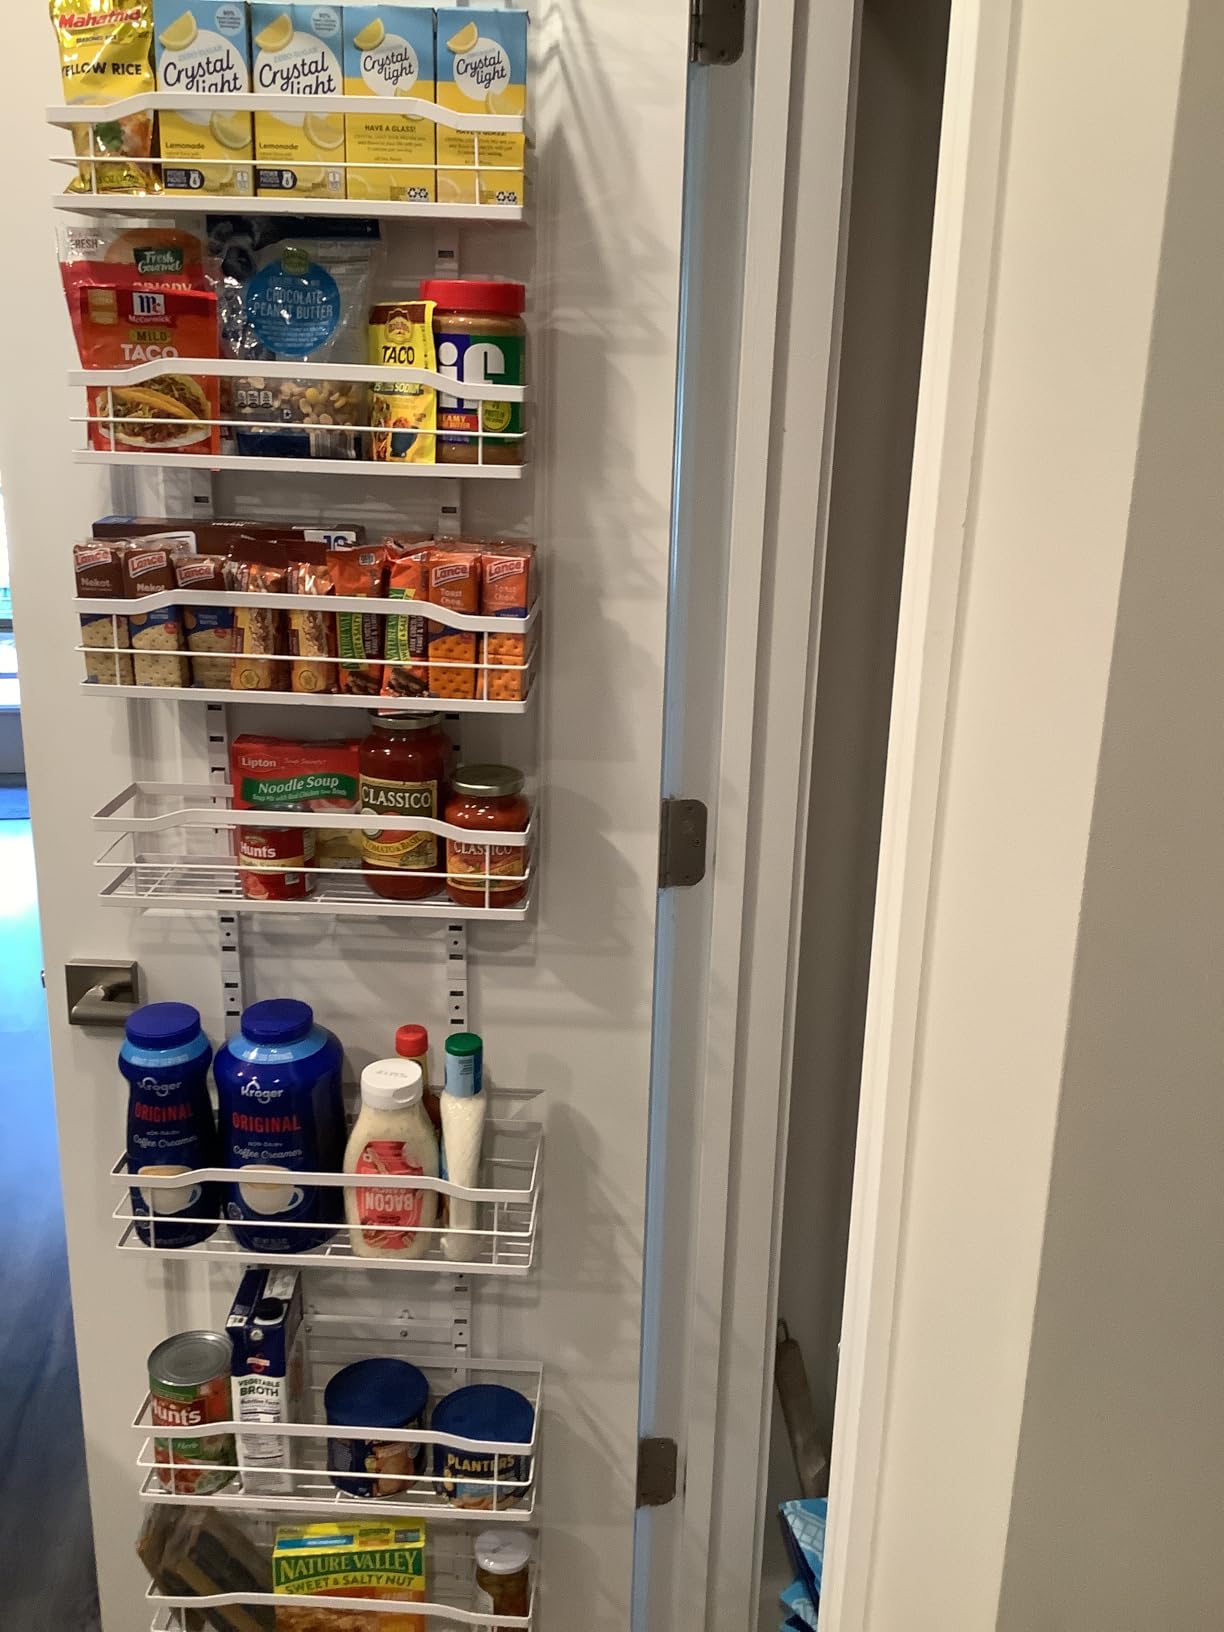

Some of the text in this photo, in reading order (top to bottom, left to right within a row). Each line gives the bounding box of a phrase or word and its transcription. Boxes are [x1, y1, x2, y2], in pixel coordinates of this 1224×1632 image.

[112, 63, 142, 75] RICE
[363, 47, 410, 74] Crystal
[456, 51, 503, 78] Crystal
[163, 49, 234, 91] Crystal
[259, 51, 329, 92] Crystal
[383, 63, 414, 86] light
[476, 67, 507, 89] light
[365, 124, 383, 132] HAVE
[165, 142, 205, 150] Lemonade
[144, 251, 175, 263] Fresh
[138, 260, 183, 273] Gourmet
[266, 287, 323, 305] CHOCOLATE
[253, 301, 333, 320] PEANT BUTTER
[137, 331, 168, 341] MILD
[120, 344, 179, 361] TACO
[382, 345, 415, 365] TACO
[131, 555, 165, 570] Lance
[489, 561, 521, 577] Lance
[179, 566, 211, 580] Lance
[435, 564, 468, 581] Lance
[241, 757, 277, 768] Lipton
[258, 776, 339, 794] Noodle Soup
[361, 786, 432, 809] CLASSICO
[453, 841, 513, 856] CLASICO
[137, 1076, 183, 1097] Kroger
[240, 1080, 284, 1104] Kroger
[135, 1101, 193, 1123] ORIGINAL
[232, 1111, 302, 1133] ORIGINAL
[133, 1134, 198, 1149] Coffee Creamer
[233, 1145, 303, 1160] Coffee Creamer
[365, 1191, 413, 1212] BACON
[238, 1378, 280, 1388] VEGETABLE
[240, 1386, 279, 1397] BROTH
[280, 1550, 417, 1583] NATURE VALLEY
[285, 1577, 329, 1595] SWEET
[342, 1574, 383, 1586] SALTY
[385, 1575, 415, 1587] NUT
